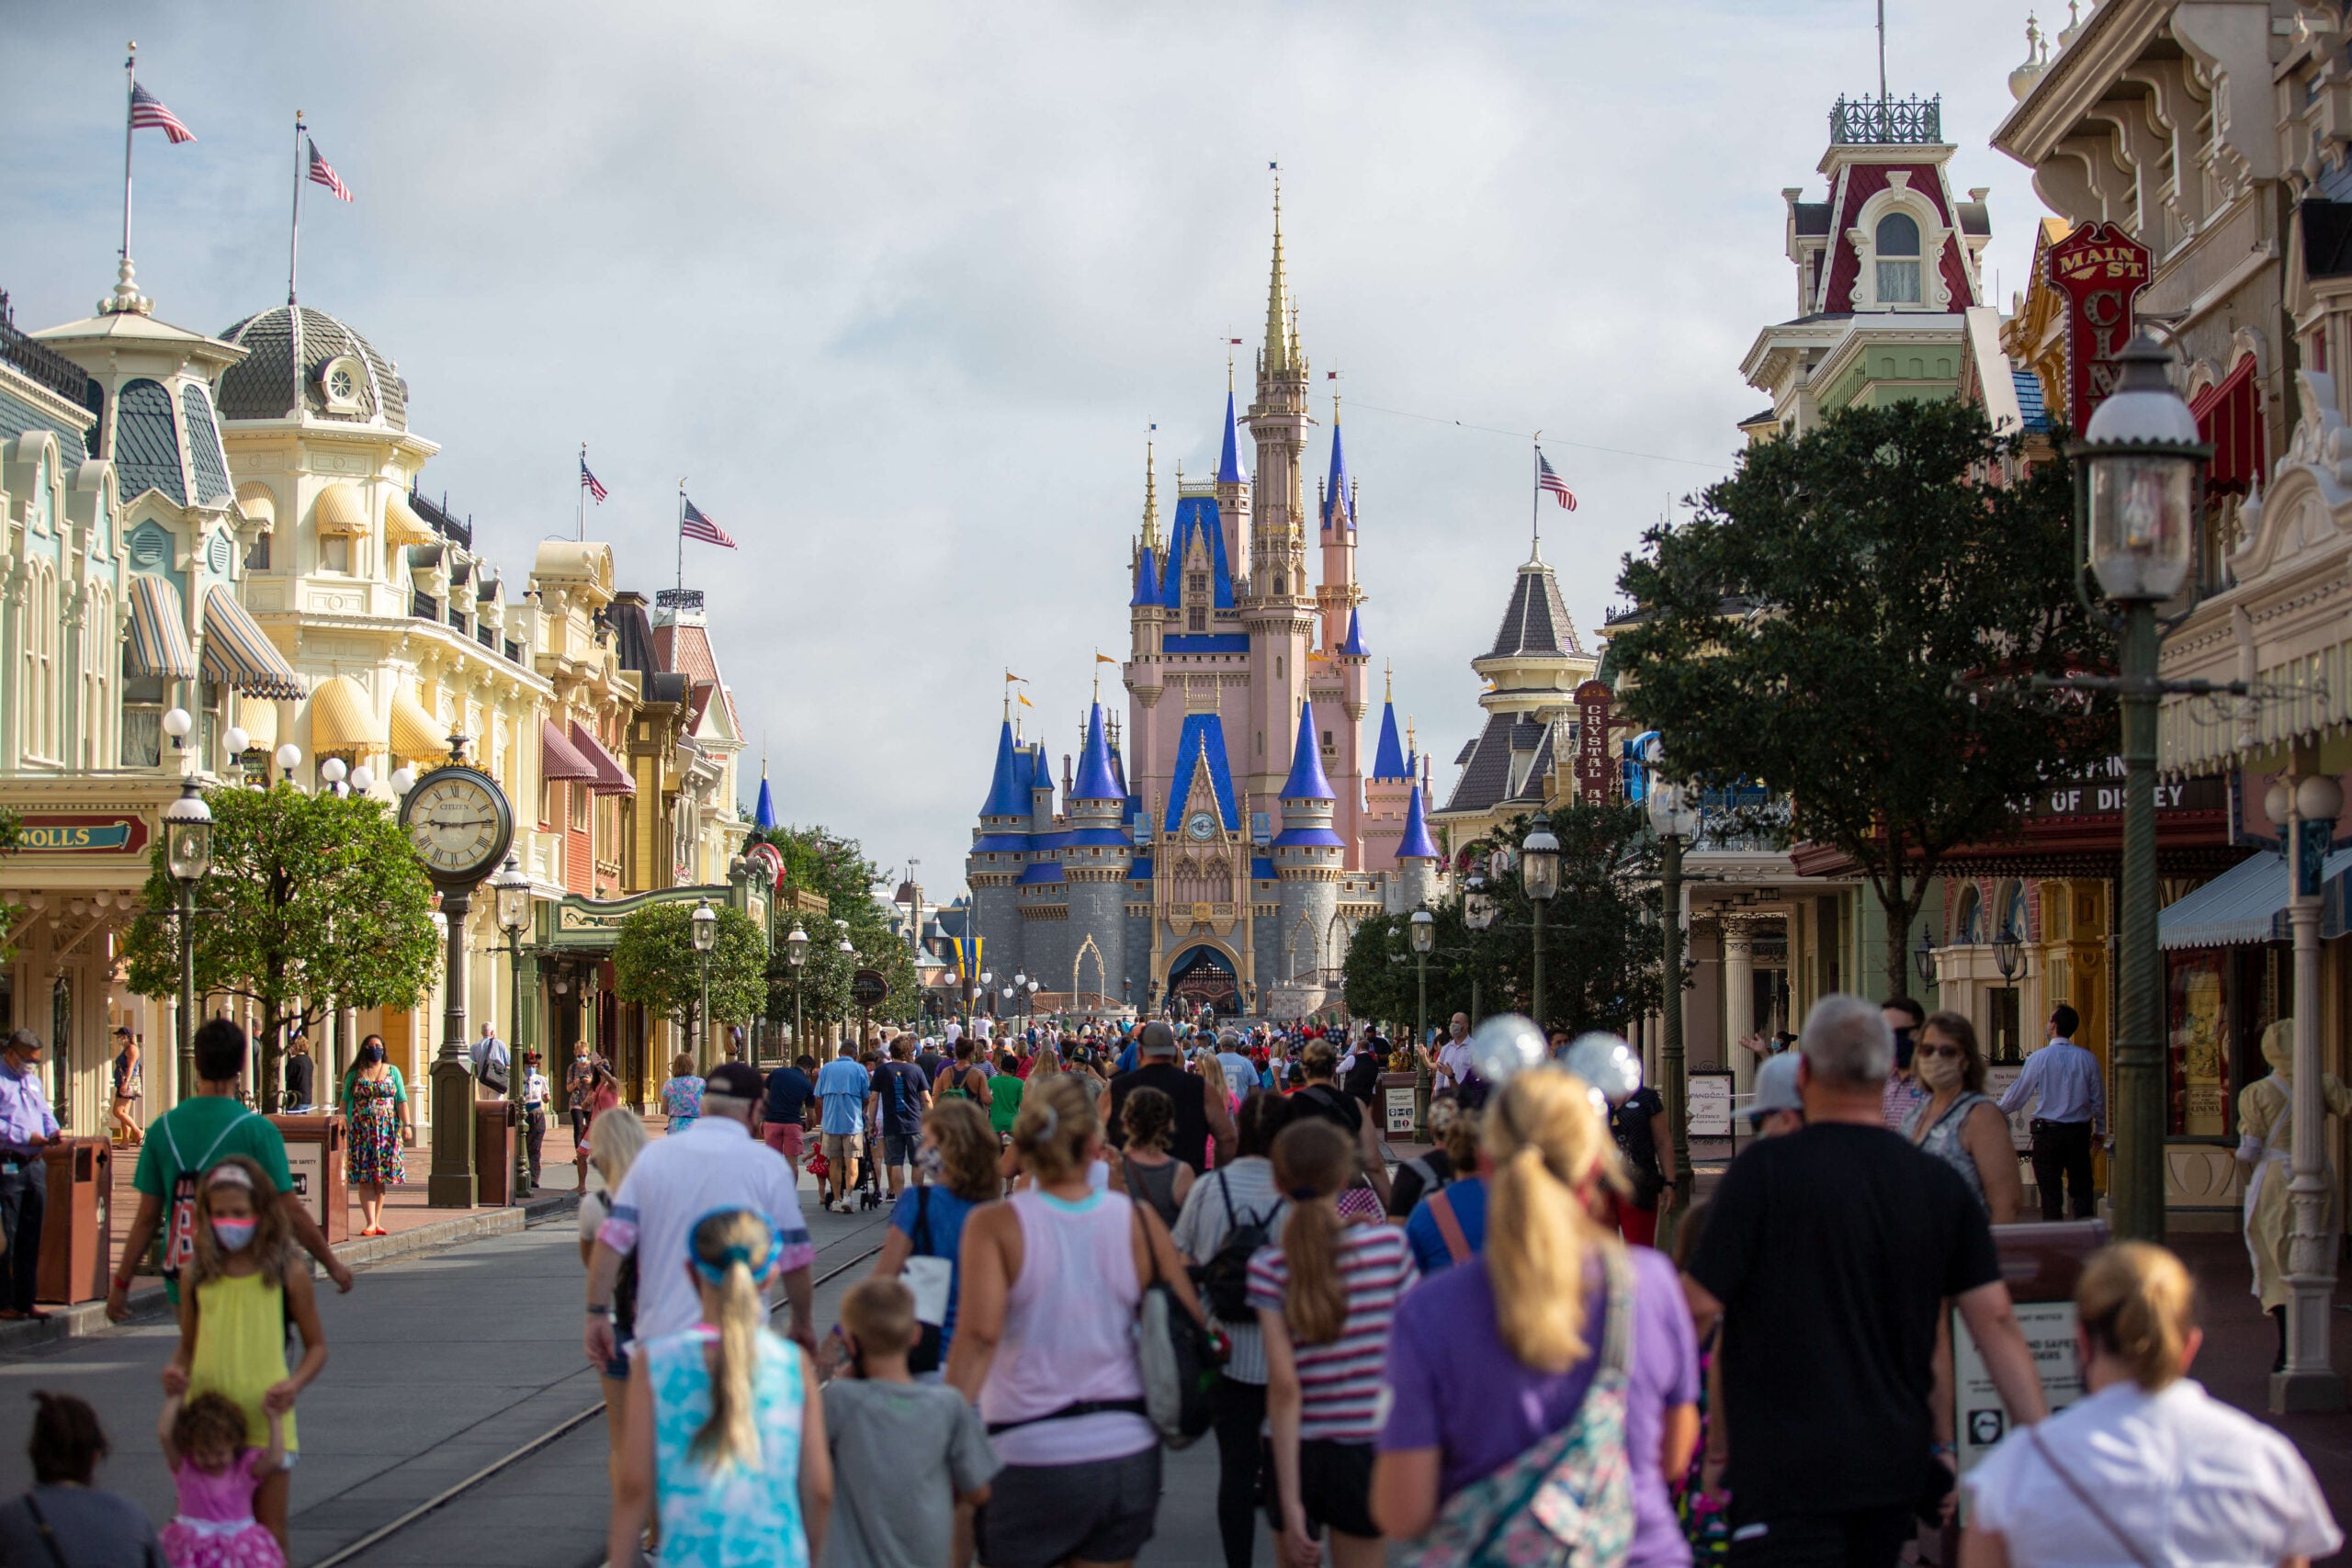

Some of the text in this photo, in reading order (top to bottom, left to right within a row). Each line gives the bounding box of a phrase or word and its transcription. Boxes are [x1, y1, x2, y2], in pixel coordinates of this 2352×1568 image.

[2059, 247, 2135, 275] MAIN
[2106, 262, 2145, 277] ST.
[2083, 289, 2123, 415] CIN
[1587, 705, 1602, 778] CRYSTAL
[2052, 790, 2081, 812] OF
[2098, 785, 2183, 810] DIEY
